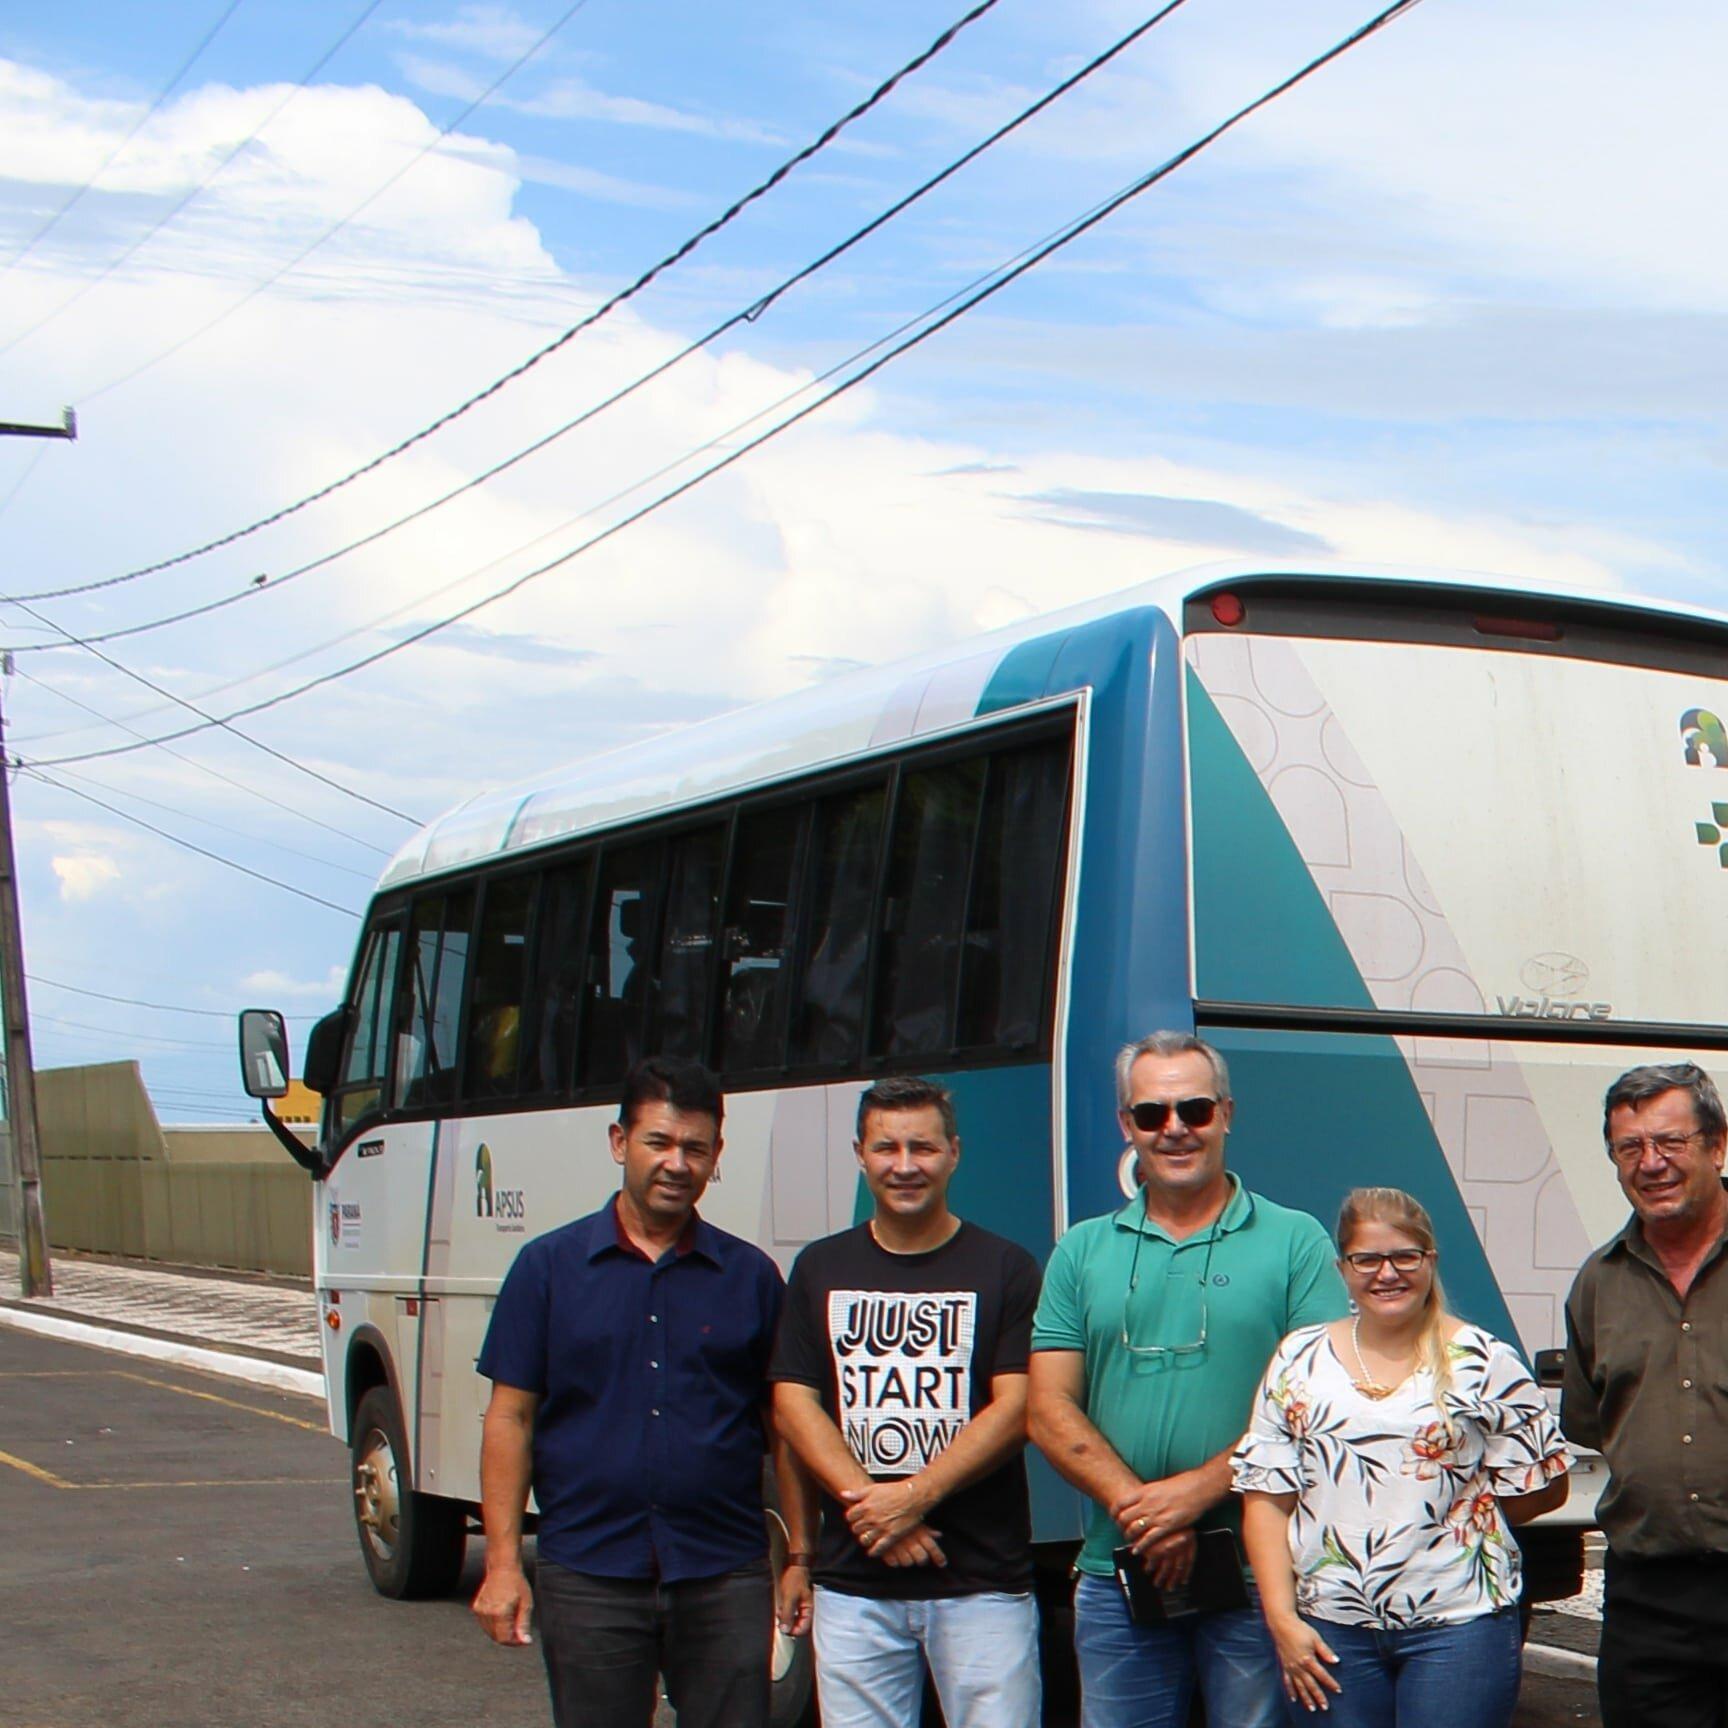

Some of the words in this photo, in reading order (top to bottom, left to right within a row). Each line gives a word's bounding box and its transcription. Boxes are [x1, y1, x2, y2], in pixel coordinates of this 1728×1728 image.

[495, 1190, 525, 1218] APSUS
[837, 1297, 969, 1357] JUST
[843, 1364, 964, 1409] START
[848, 1415, 964, 1466] NOW
